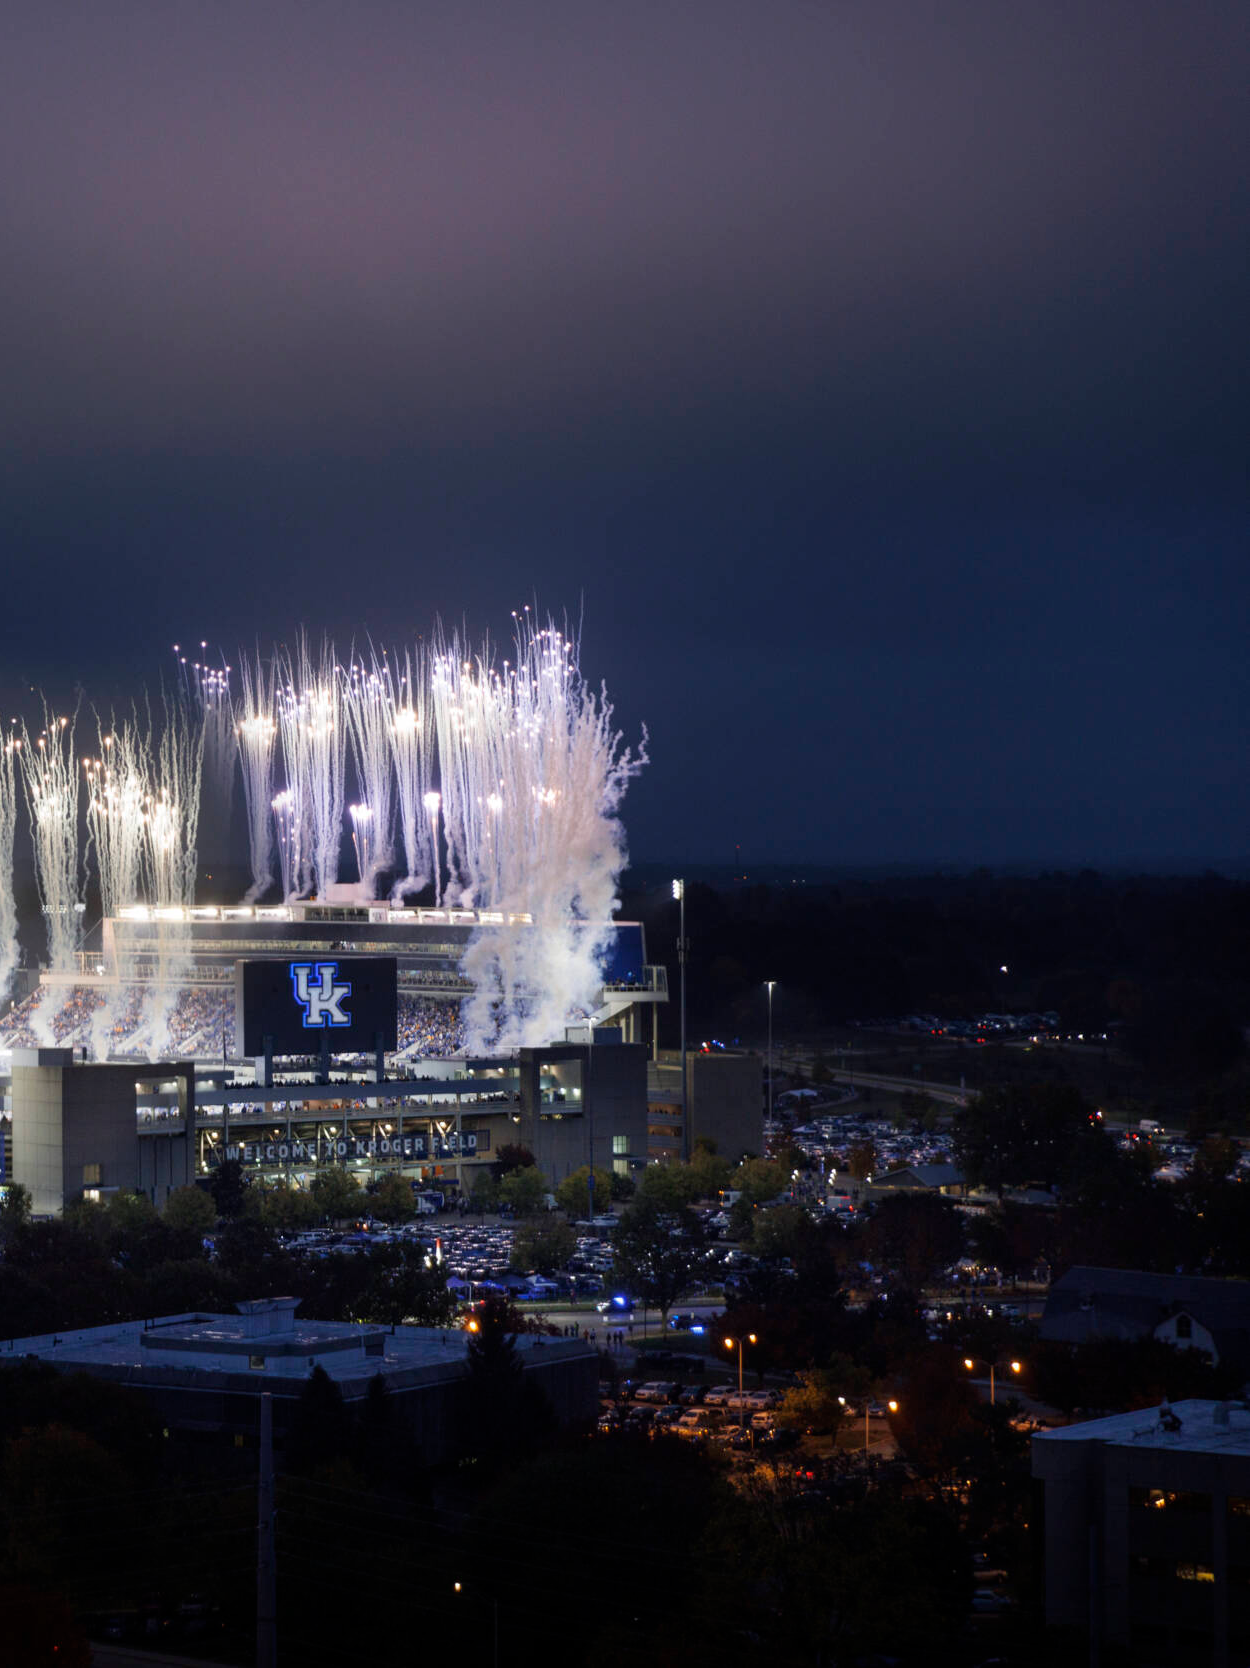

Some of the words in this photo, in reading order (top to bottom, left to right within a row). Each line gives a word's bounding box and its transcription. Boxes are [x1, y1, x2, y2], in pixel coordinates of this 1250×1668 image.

[290, 962, 351, 1027] UK
[226, 1143, 316, 1160] WELCOME
[325, 1142, 347, 1156] TO
[356, 1137, 424, 1155] KROGER
[432, 1135, 477, 1151] FIELD
